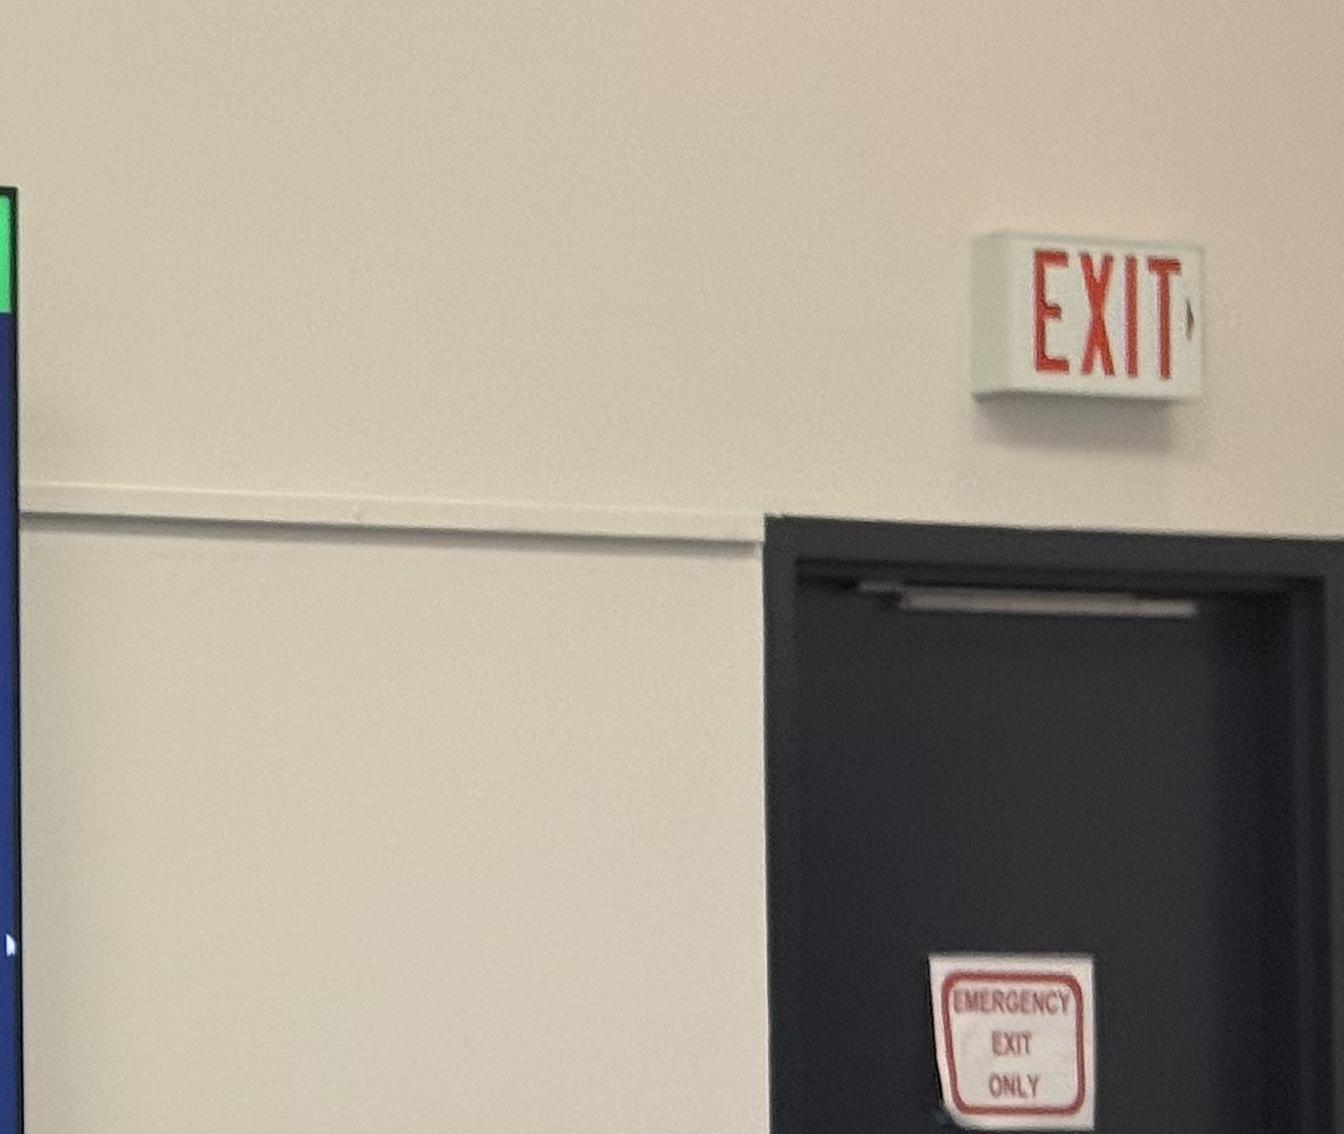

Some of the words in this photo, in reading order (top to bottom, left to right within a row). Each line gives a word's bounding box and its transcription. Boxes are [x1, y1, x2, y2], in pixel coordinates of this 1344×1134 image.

[1033, 249, 1181, 381] EXIT
[953, 988, 1070, 1015] EMERGENCY
[992, 1031, 1032, 1056] EXIT
[989, 1072, 1040, 1097] ONLY
